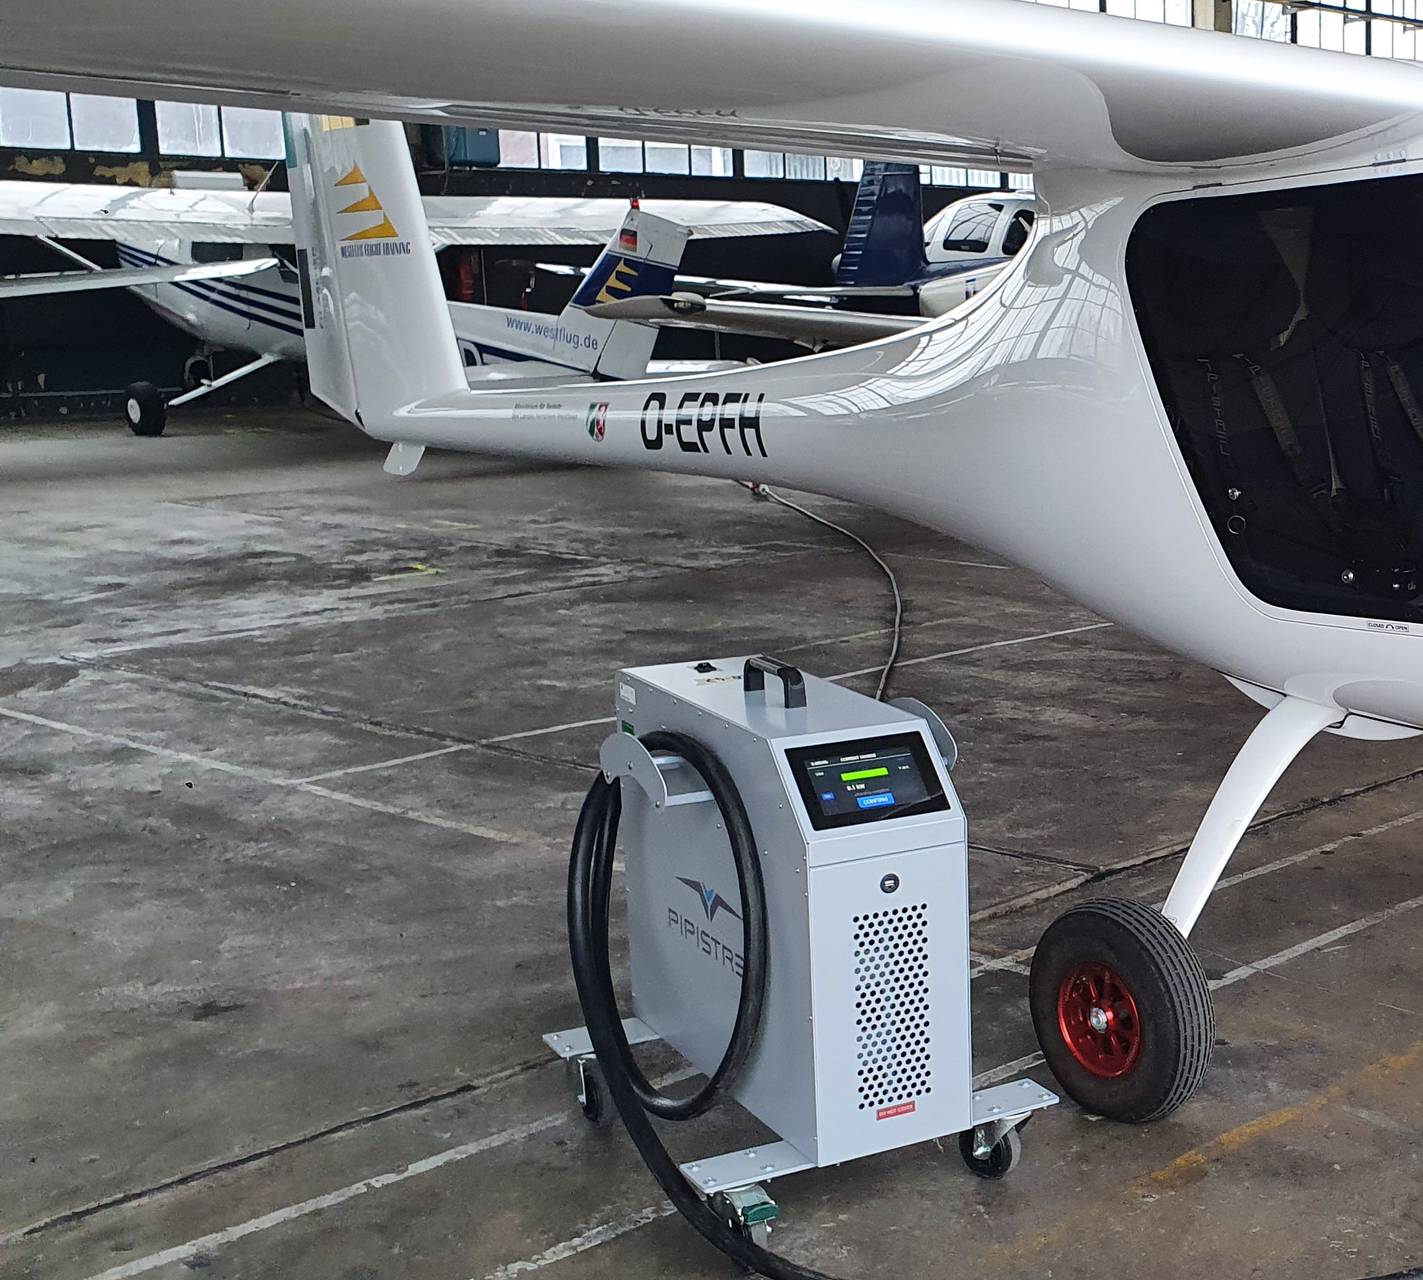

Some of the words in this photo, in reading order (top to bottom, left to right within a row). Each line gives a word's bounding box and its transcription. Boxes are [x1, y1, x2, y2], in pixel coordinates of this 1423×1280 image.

[506, 314, 598, 351] www.westflug.de
[640, 392, 768, 457] D-EPFH
[667, 906, 745, 979] PIPISTRE
